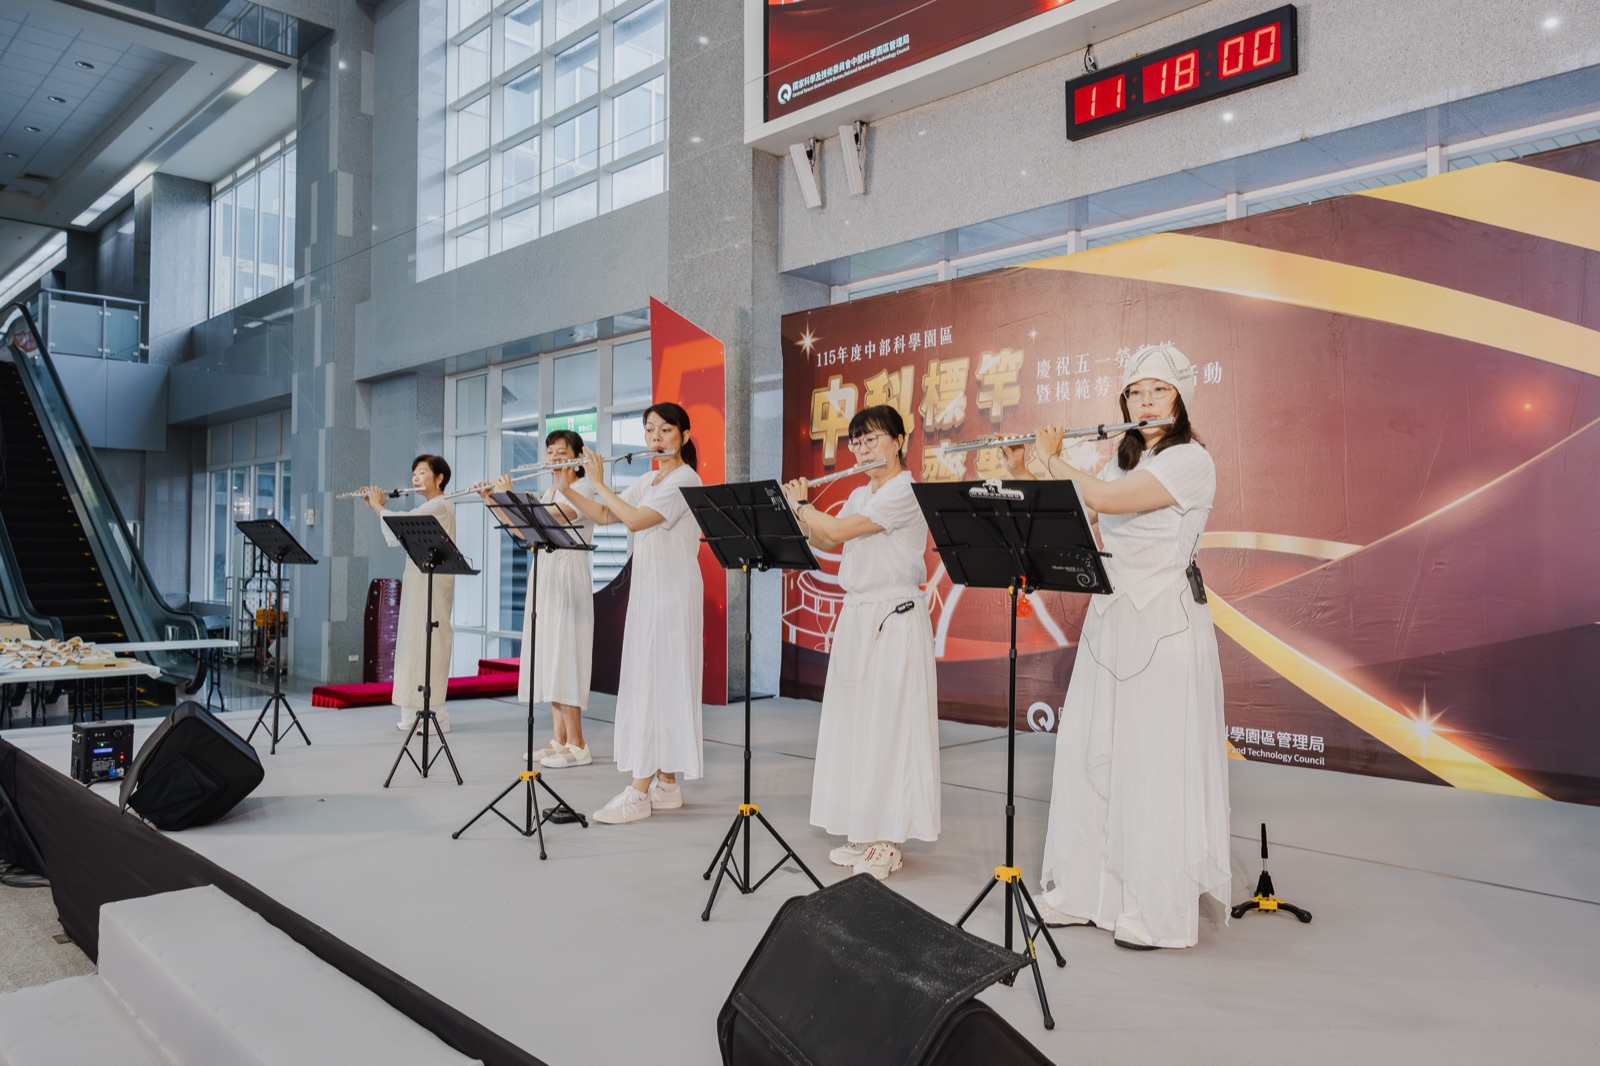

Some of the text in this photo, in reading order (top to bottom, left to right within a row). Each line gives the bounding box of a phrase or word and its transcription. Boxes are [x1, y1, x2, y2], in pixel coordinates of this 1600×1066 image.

[817, 326, 953, 367] 115年度中部科學園區
[1036, 341, 1176, 379] 慶祝五一勞
[1231, 747, 1246, 755] and
[1247, 748, 1293, 762] Technology
[1293, 754, 1325, 766] Council
